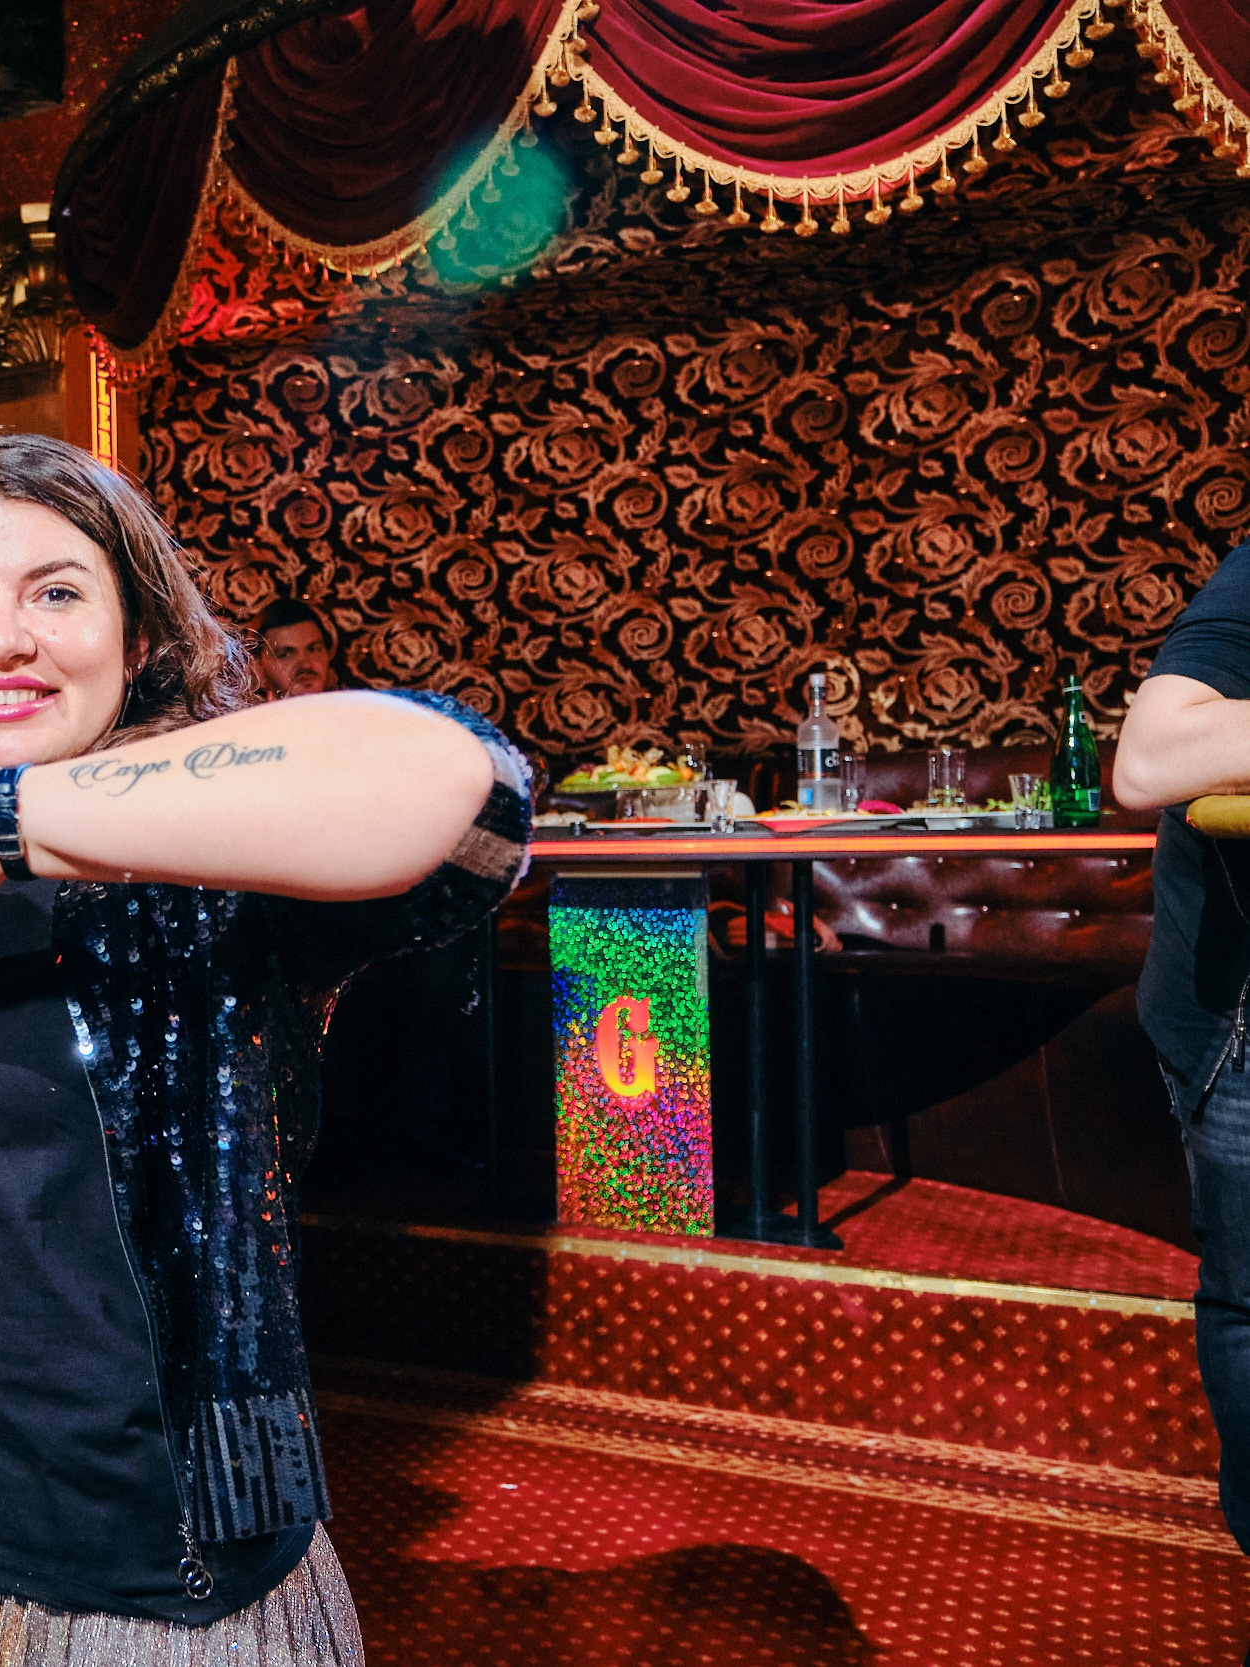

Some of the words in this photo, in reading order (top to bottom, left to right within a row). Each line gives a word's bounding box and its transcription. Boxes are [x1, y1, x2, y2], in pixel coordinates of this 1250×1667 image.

[69, 759, 171, 797] Carpe
[183, 741, 288, 779] Diem
[596, 996, 660, 1097] G
